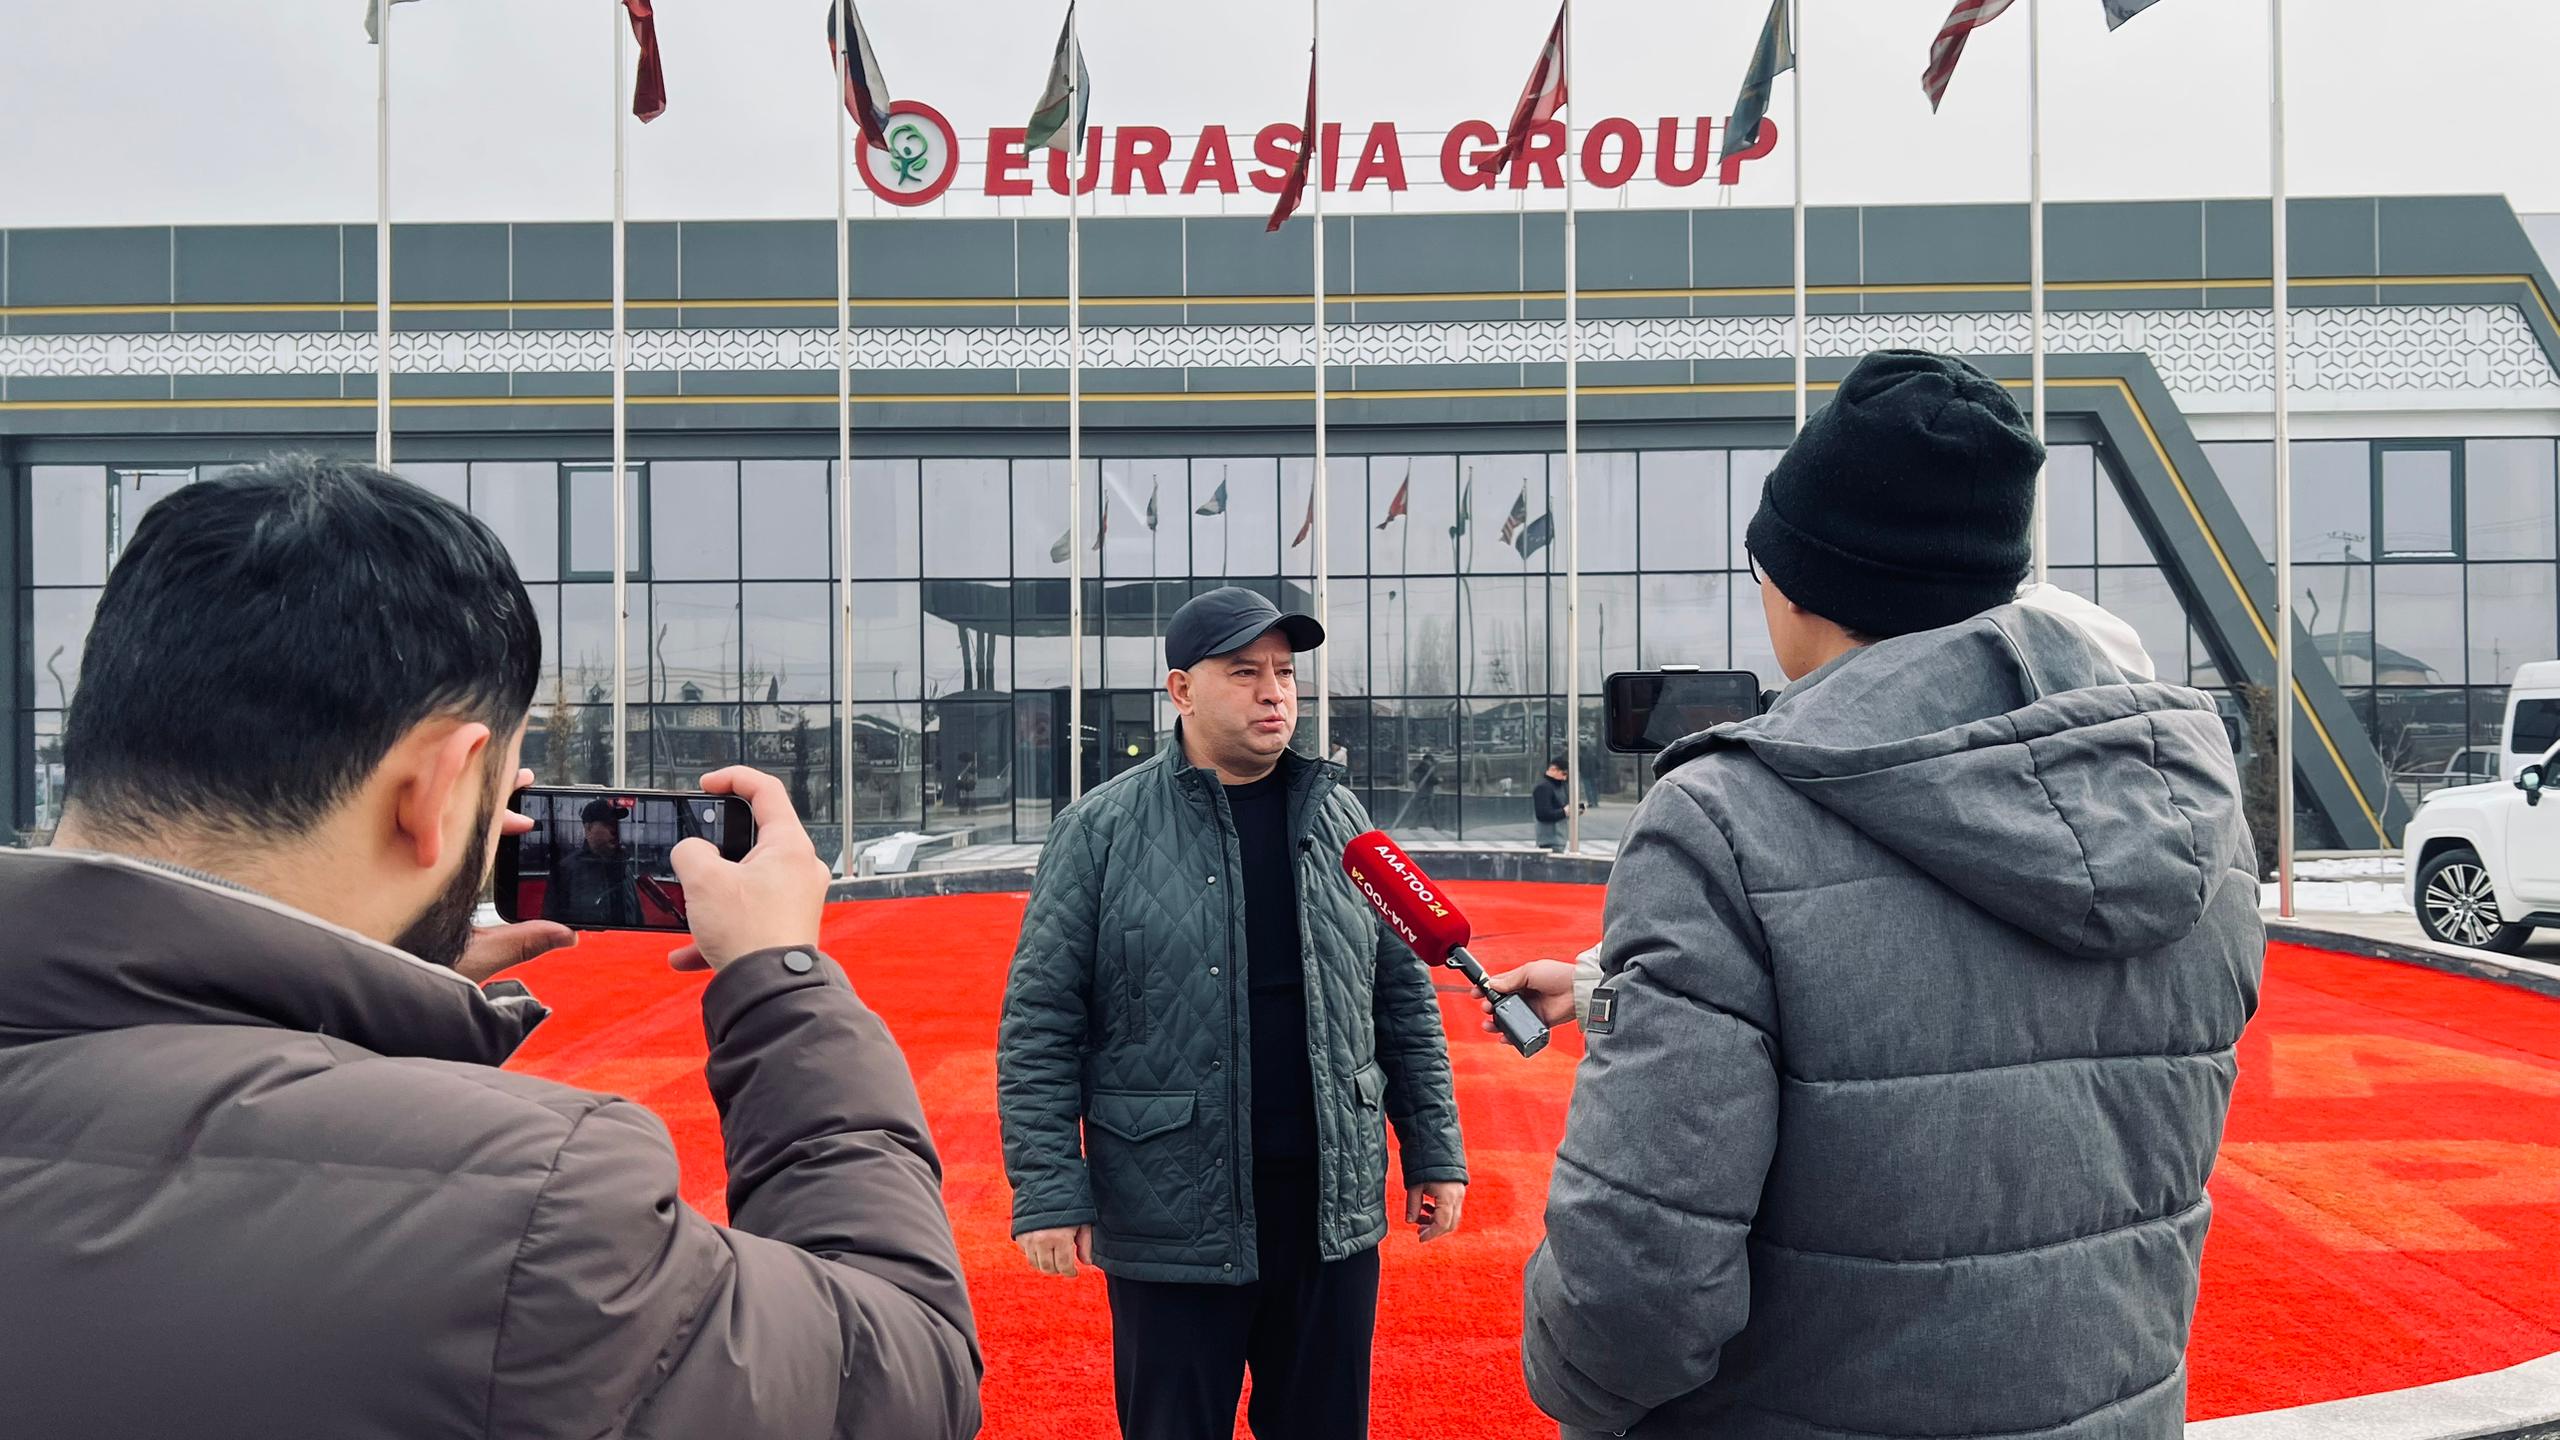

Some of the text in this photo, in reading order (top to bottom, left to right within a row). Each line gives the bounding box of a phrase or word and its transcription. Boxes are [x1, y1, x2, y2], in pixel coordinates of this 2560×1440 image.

[984, 117, 1778, 196] EURASIA GROUP
[1427, 901, 1450, 918] 24
